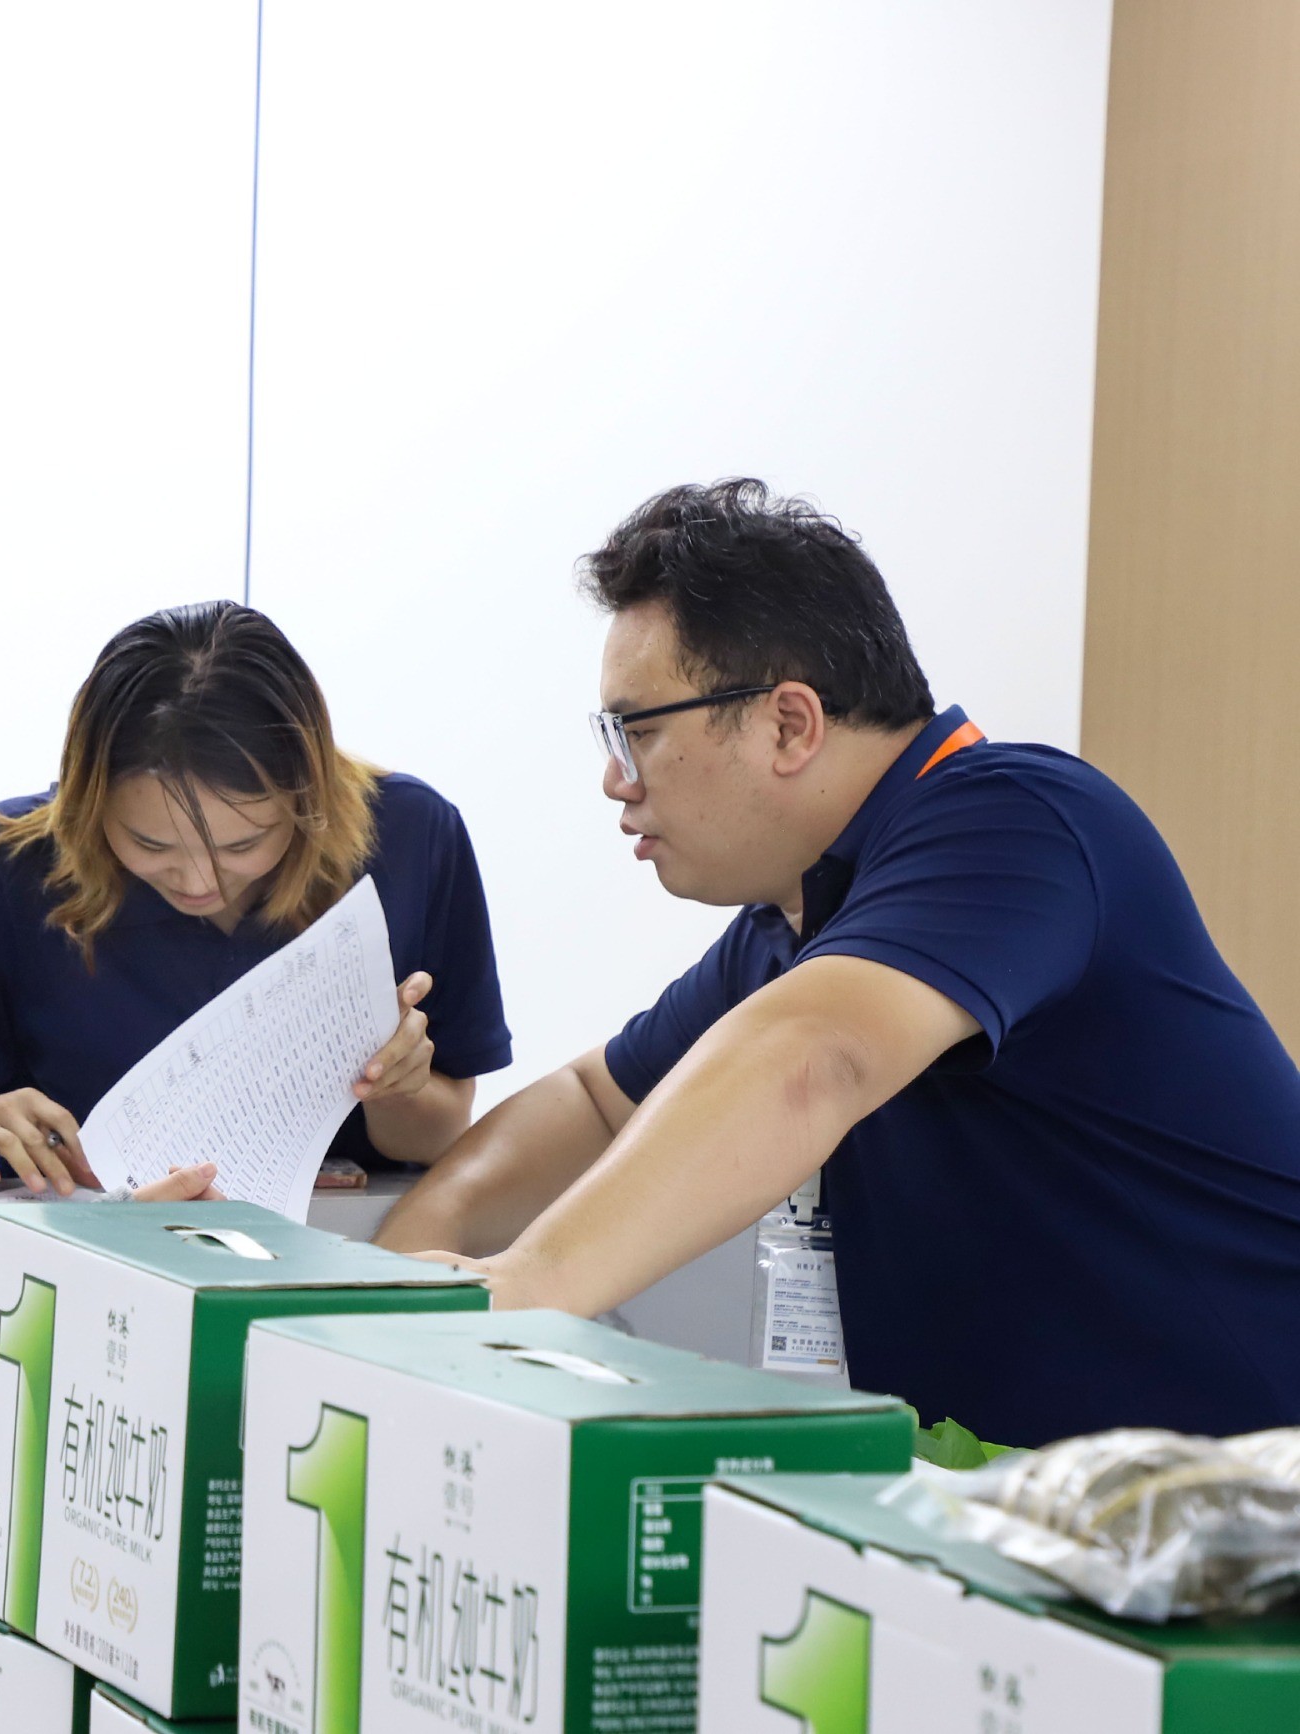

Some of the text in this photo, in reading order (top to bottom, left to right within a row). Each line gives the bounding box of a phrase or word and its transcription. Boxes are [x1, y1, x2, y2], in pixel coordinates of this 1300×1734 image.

[60, 1383, 168, 1542] 有机纯牛奶
[64, 1505, 153, 1566] ORGANIC PURE MILK
[382, 1532, 539, 1725] 有机纯牛奶
